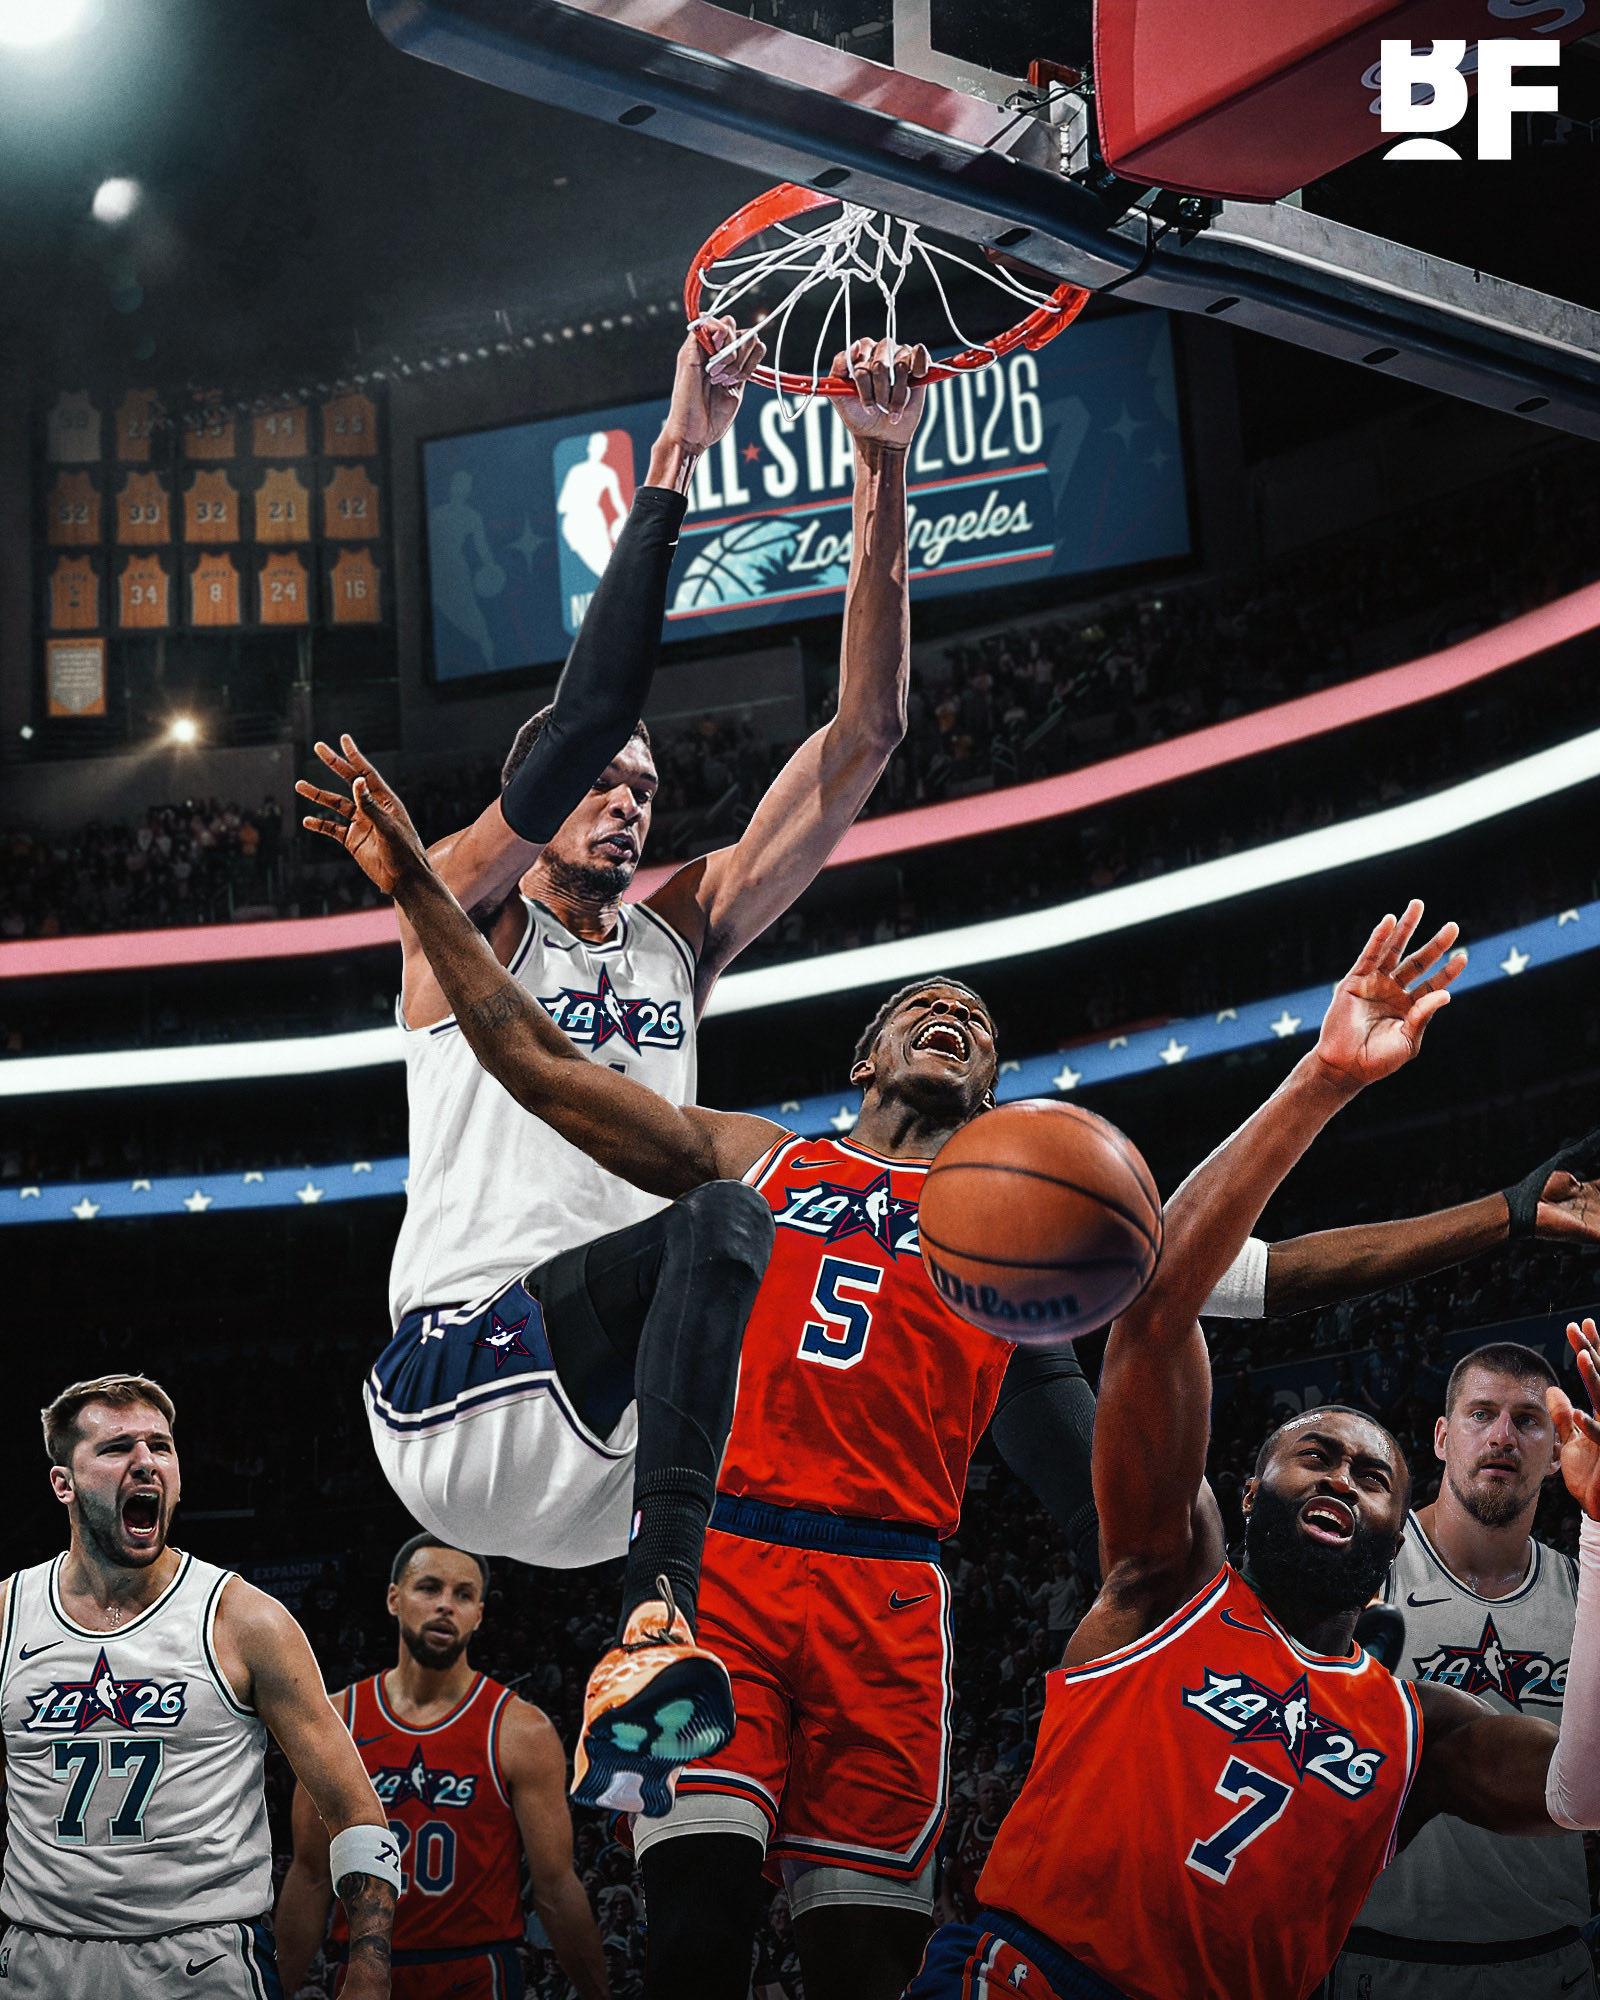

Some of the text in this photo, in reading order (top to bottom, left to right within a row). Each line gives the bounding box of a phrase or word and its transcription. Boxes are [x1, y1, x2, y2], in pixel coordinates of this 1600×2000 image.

[266, 416, 294, 435] 44
[915, 354, 1043, 473] 2026
[130, 504, 160, 525] 33
[198, 502, 227, 524] 32
[269, 502, 296, 523] 21
[338, 498, 367, 520] 42
[907, 490, 1033, 566] ngeles
[131, 585, 158, 605] 34
[210, 583, 222, 603] 8
[271, 582, 297, 603] 24
[637, 1005, 680, 1045] 26
[774, 1187, 849, 1233] LA
[928, 1256, 1080, 1320] Wilson
[797, 1254, 884, 1370] 5
[27, 1686, 183, 1729] LA 26
[1188, 1675, 1381, 1795] LA 26
[52, 1740, 164, 1845] 77
[433, 1776, 474, 1806] 26
[1185, 1755, 1294, 1885] 7
